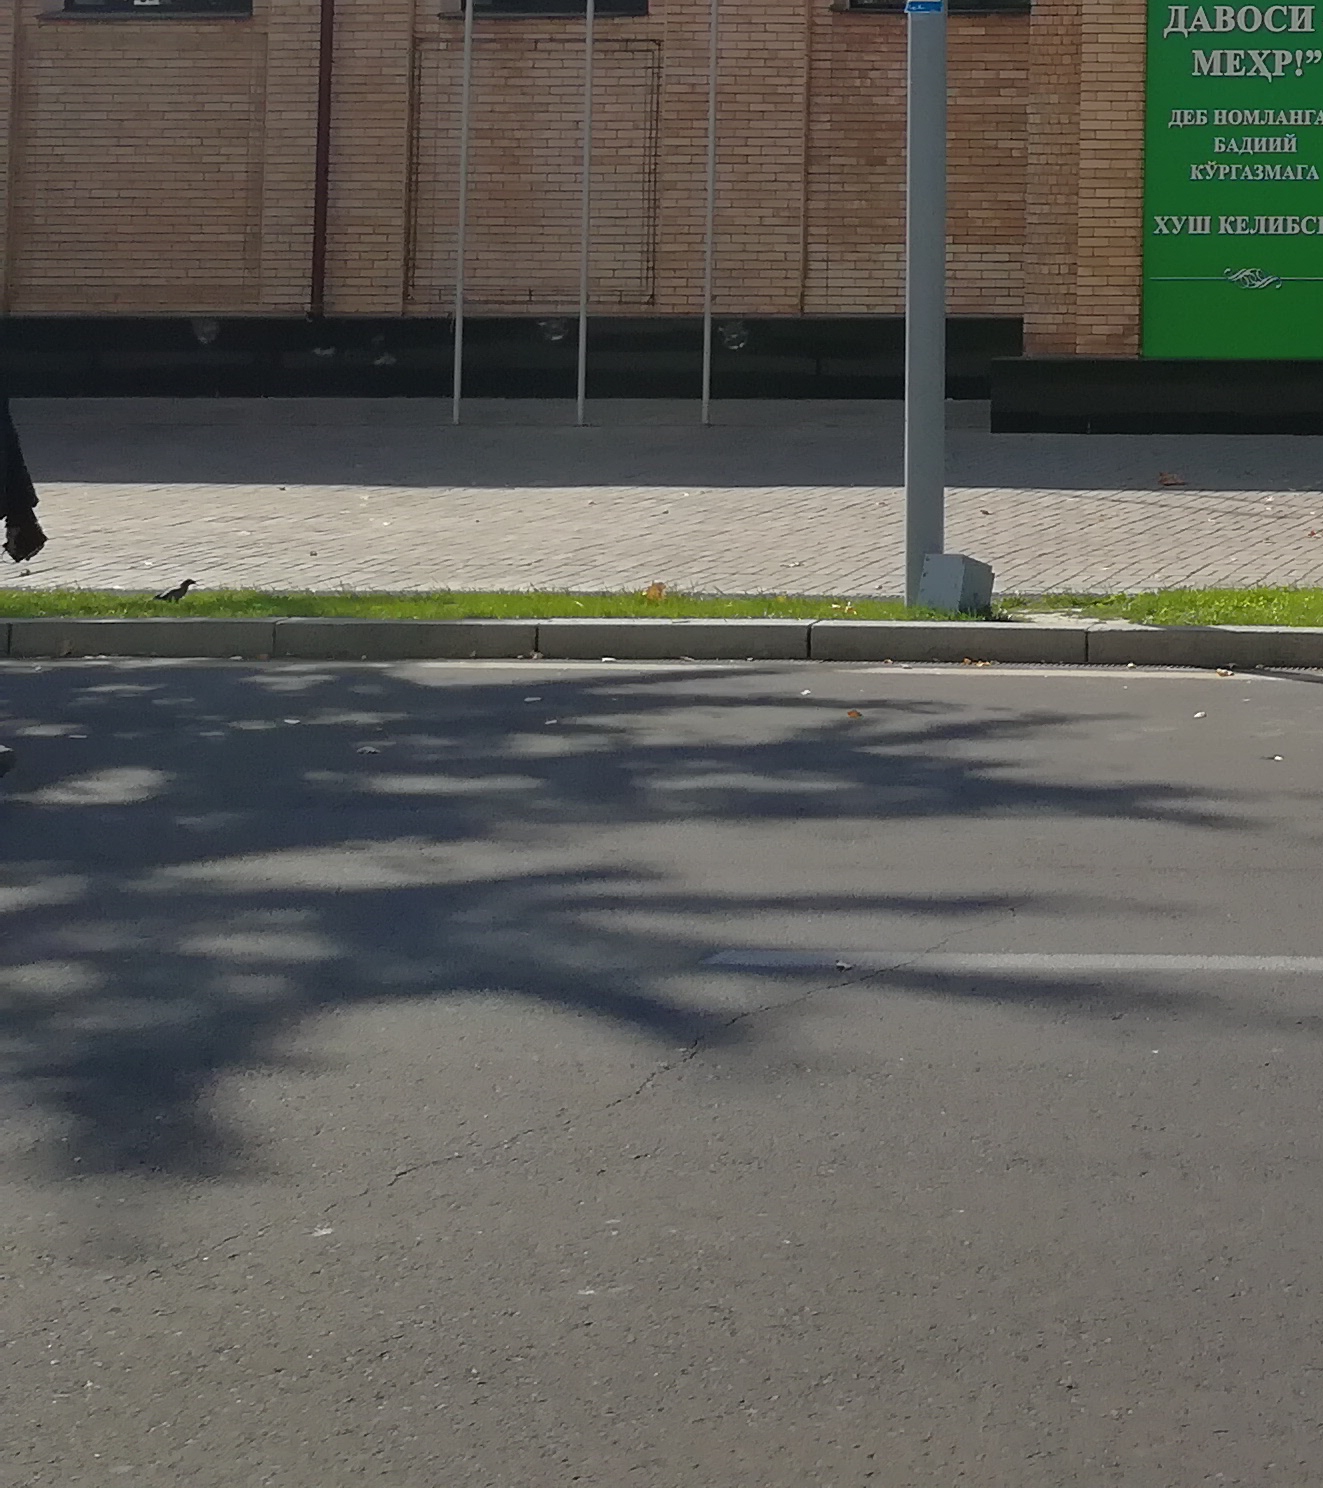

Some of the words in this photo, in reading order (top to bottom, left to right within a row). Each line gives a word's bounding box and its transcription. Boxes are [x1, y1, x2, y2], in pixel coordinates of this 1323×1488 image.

[1163, 5, 1316, 39] ДАВОСИ
[1168, 109, 1208, 129] ДЕБ
[1213, 133, 1298, 155] БАДИИЙ
[1190, 161, 1320, 181] КЎРГАЗМАГА
[1153, 216, 1212, 236] ХУШ
